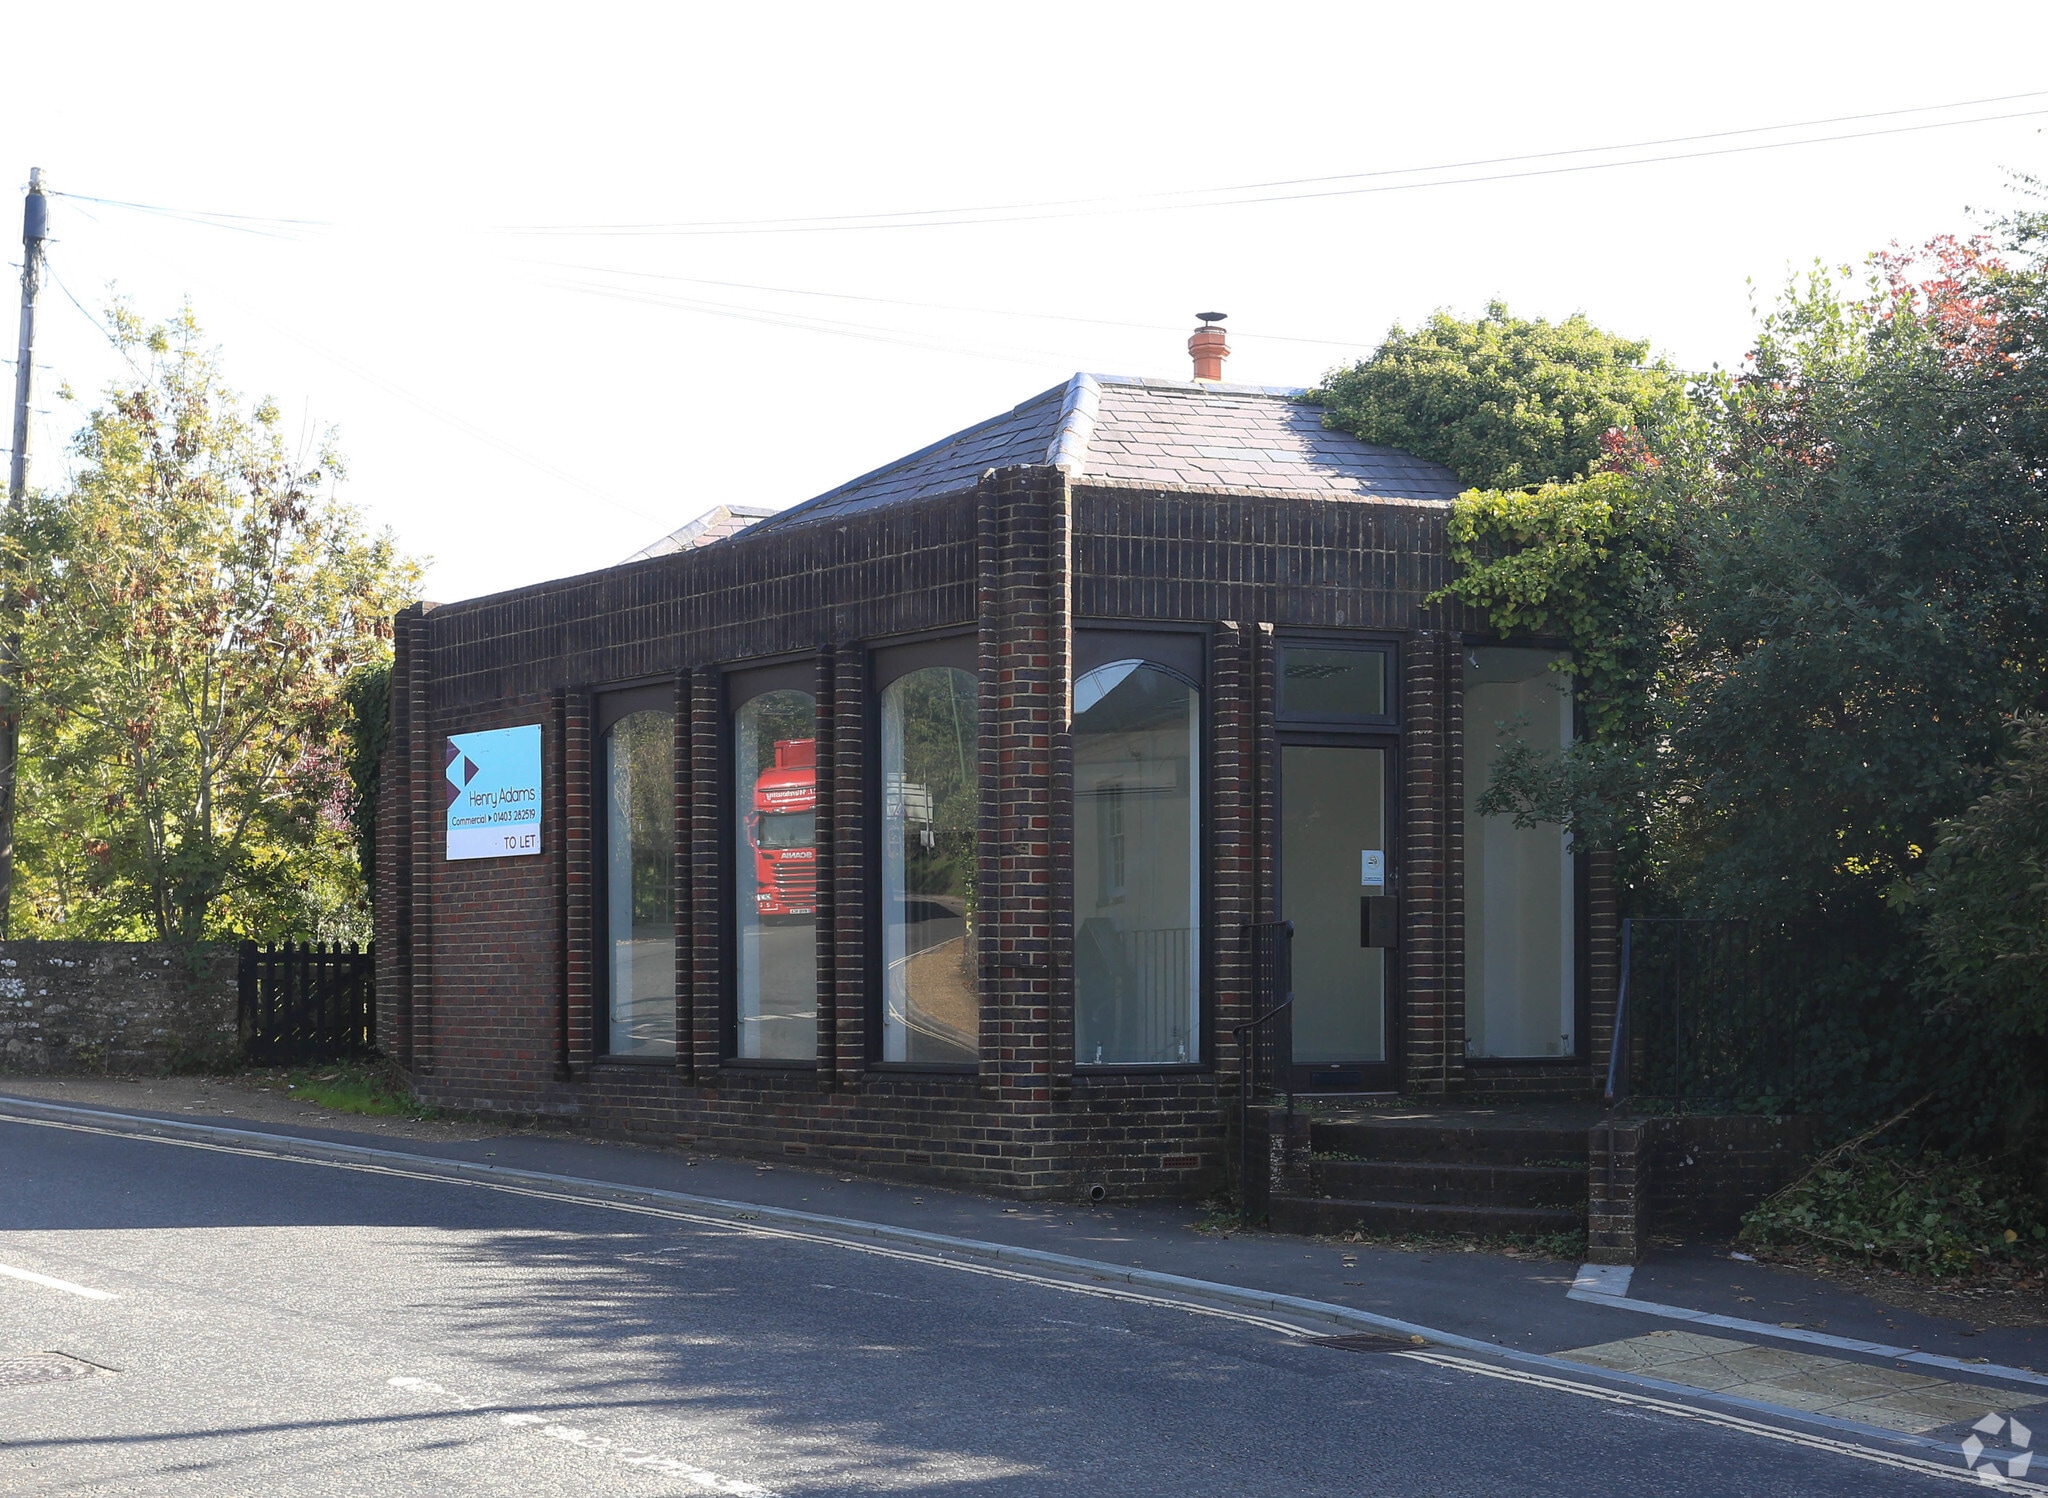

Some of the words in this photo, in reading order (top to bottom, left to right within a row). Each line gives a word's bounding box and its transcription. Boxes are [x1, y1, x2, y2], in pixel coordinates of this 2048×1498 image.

[469, 790, 497, 808] Henry
[499, 786, 535, 803] Adams
[452, 814, 486, 826] Commercial
[493, 810, 512, 822] 01403
[514, 808, 536, 821] 282519
[504, 836, 517, 849] TO
[520, 834, 536, 849] LET
